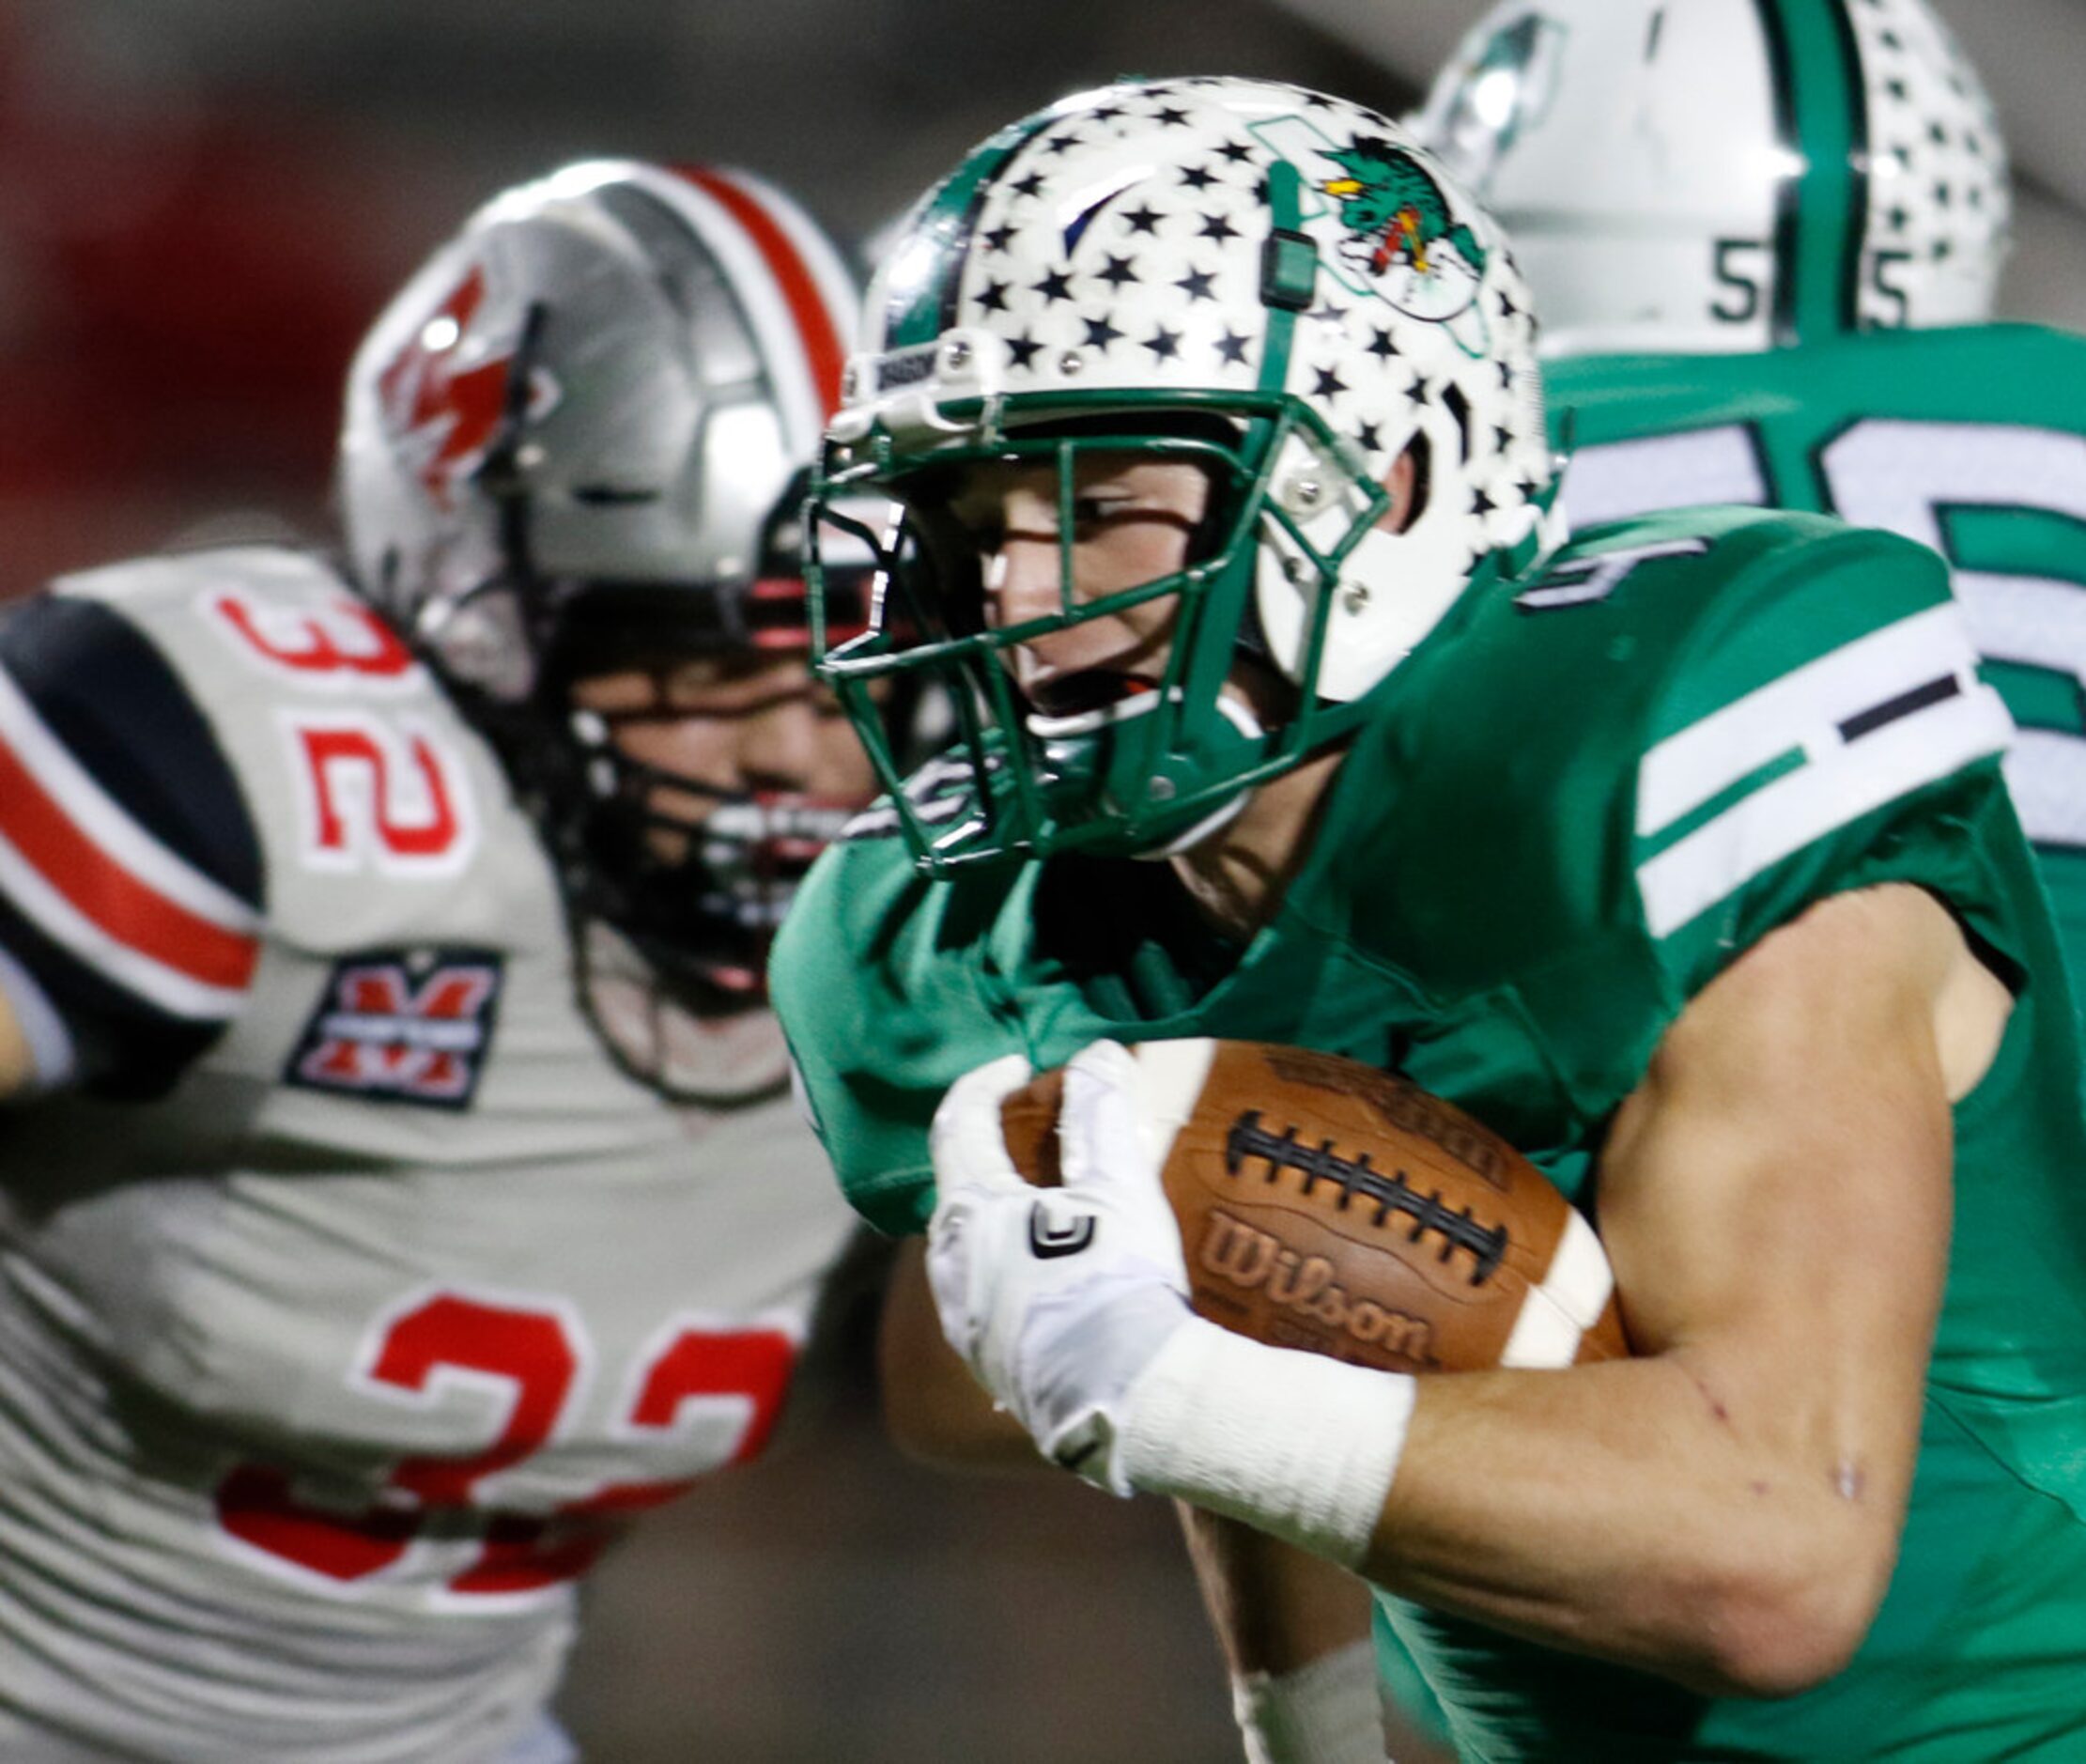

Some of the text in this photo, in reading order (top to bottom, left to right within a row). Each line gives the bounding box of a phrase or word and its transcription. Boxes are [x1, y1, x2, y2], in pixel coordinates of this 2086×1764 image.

[1707, 238, 1910, 330] 5 5
[212, 590, 466, 859] 32
[1201, 1207, 1430, 1360] Wilson
[212, 1287, 808, 1602] 32
